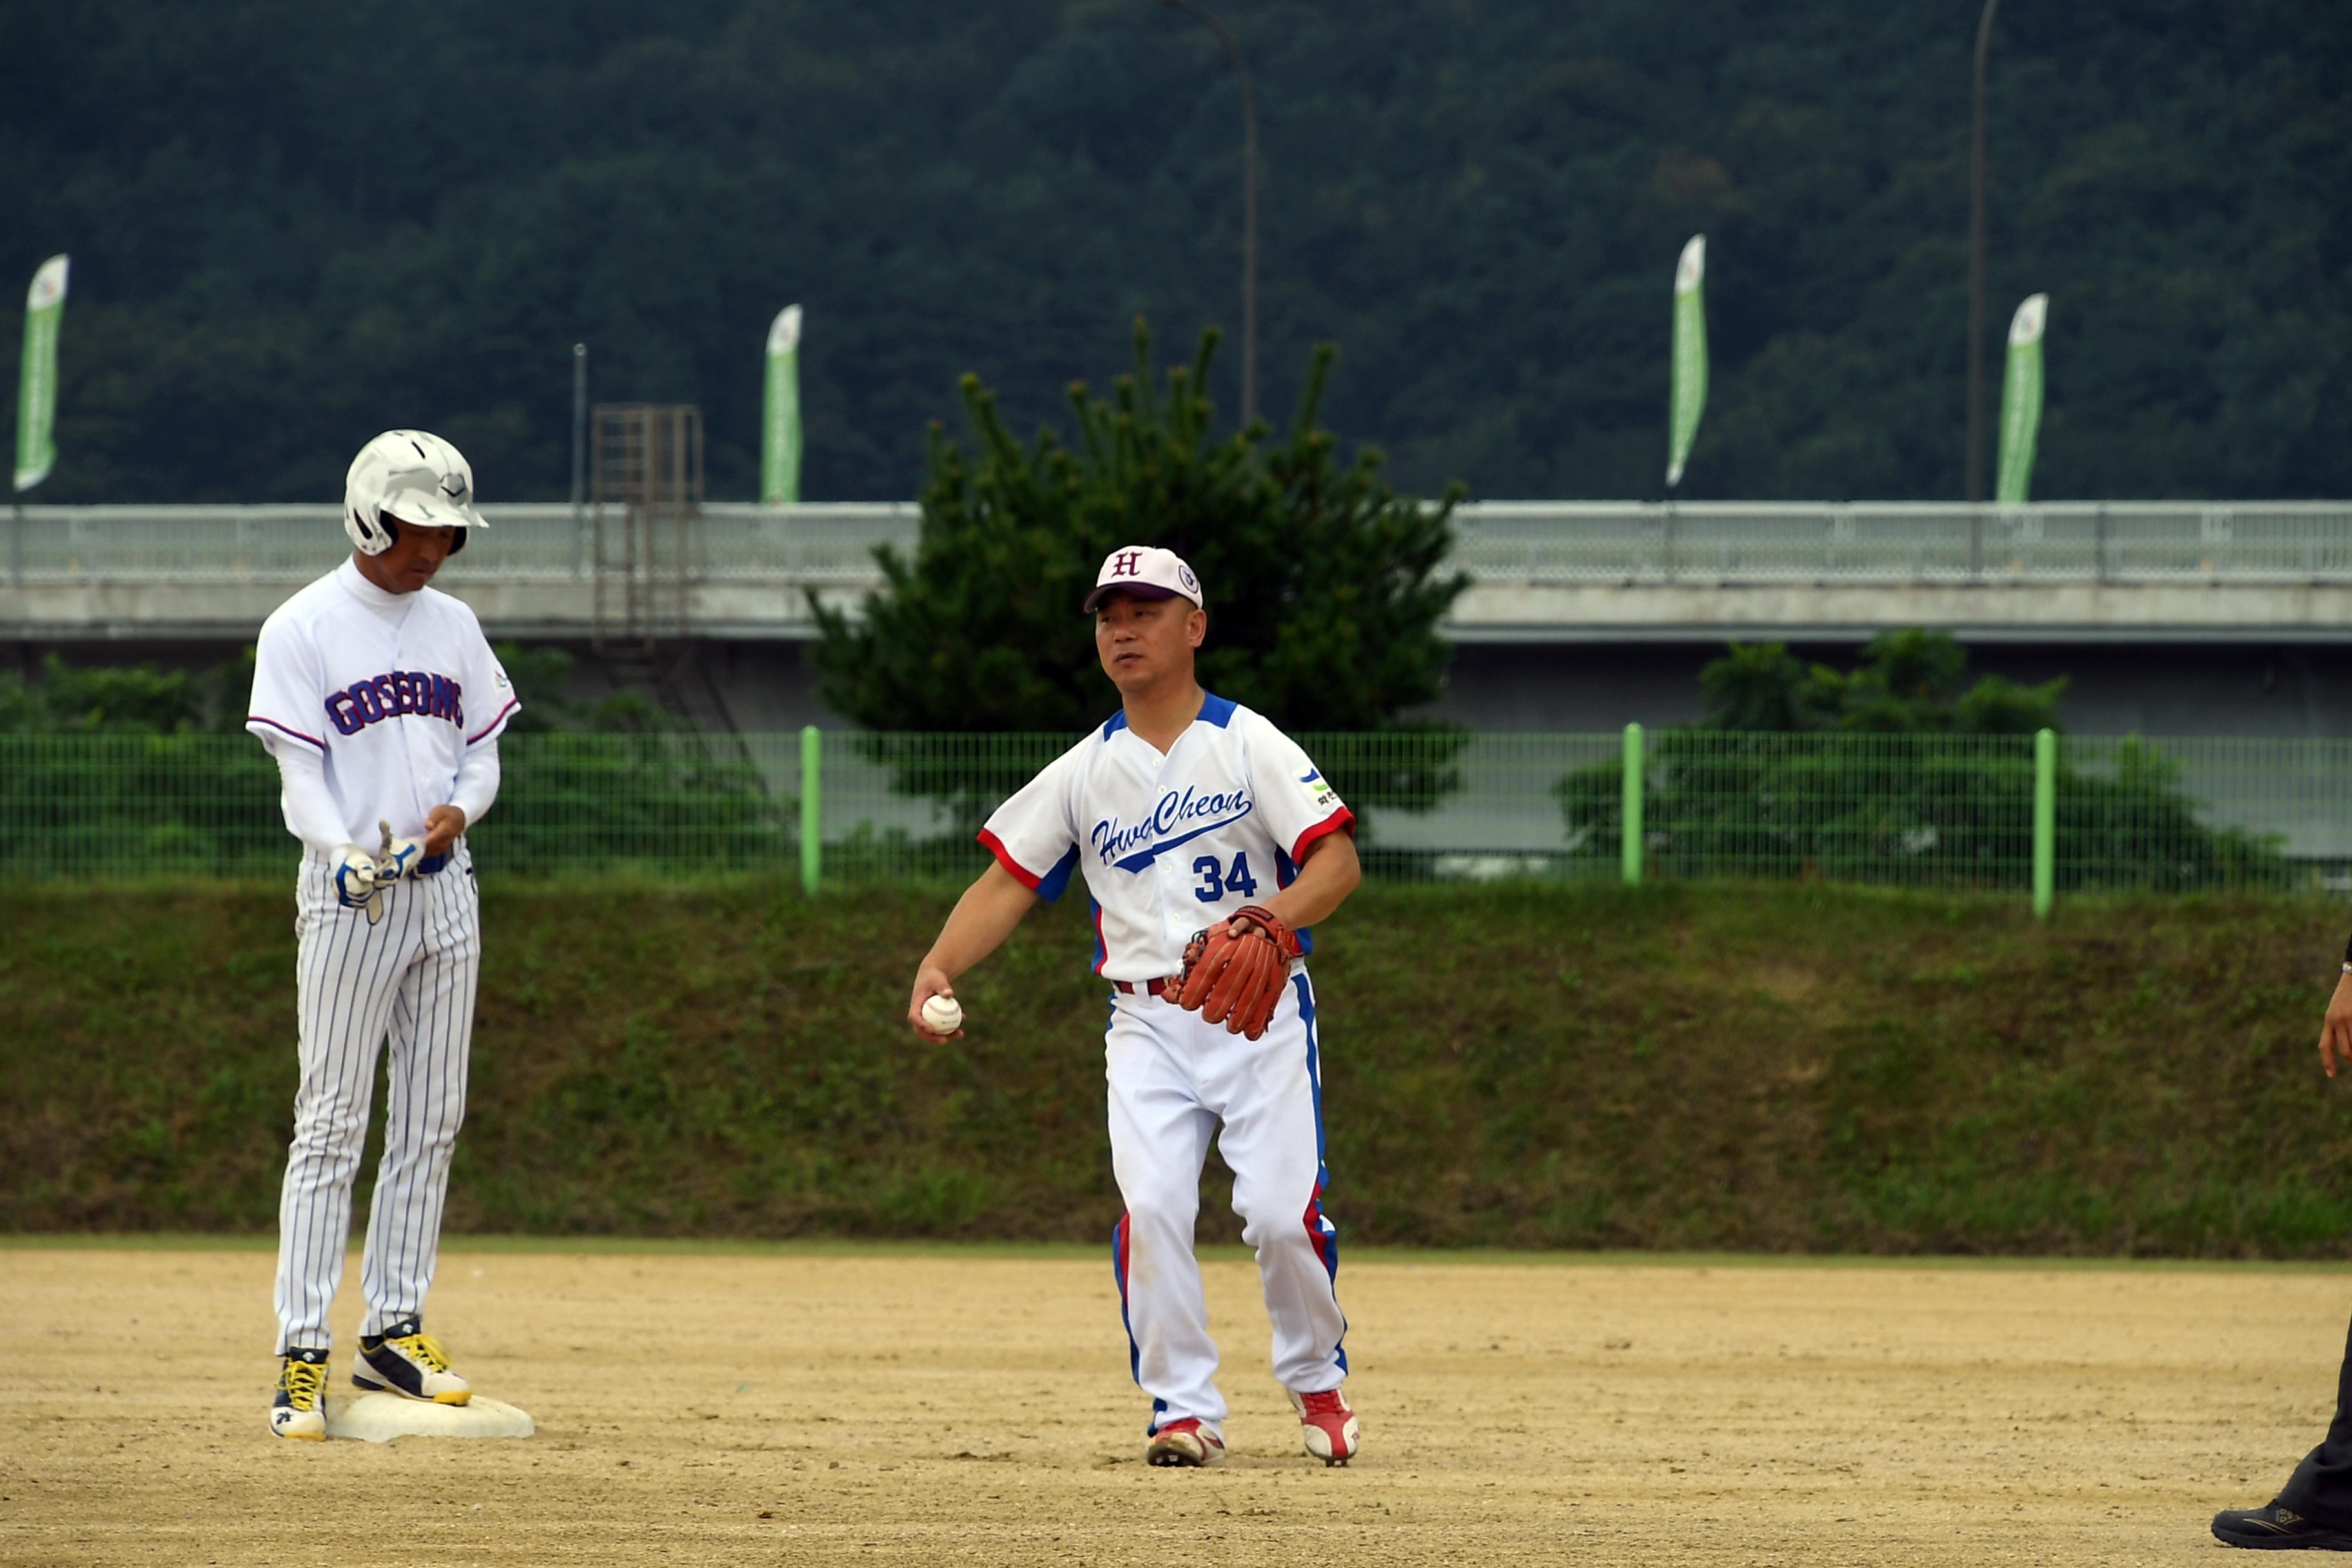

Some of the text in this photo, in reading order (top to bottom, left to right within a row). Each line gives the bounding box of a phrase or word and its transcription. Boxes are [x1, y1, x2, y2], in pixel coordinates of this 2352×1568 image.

[1111, 551, 1142, 578] H
[1092, 784, 1250, 866] HwaCheon
[1192, 851, 1257, 902] 34
